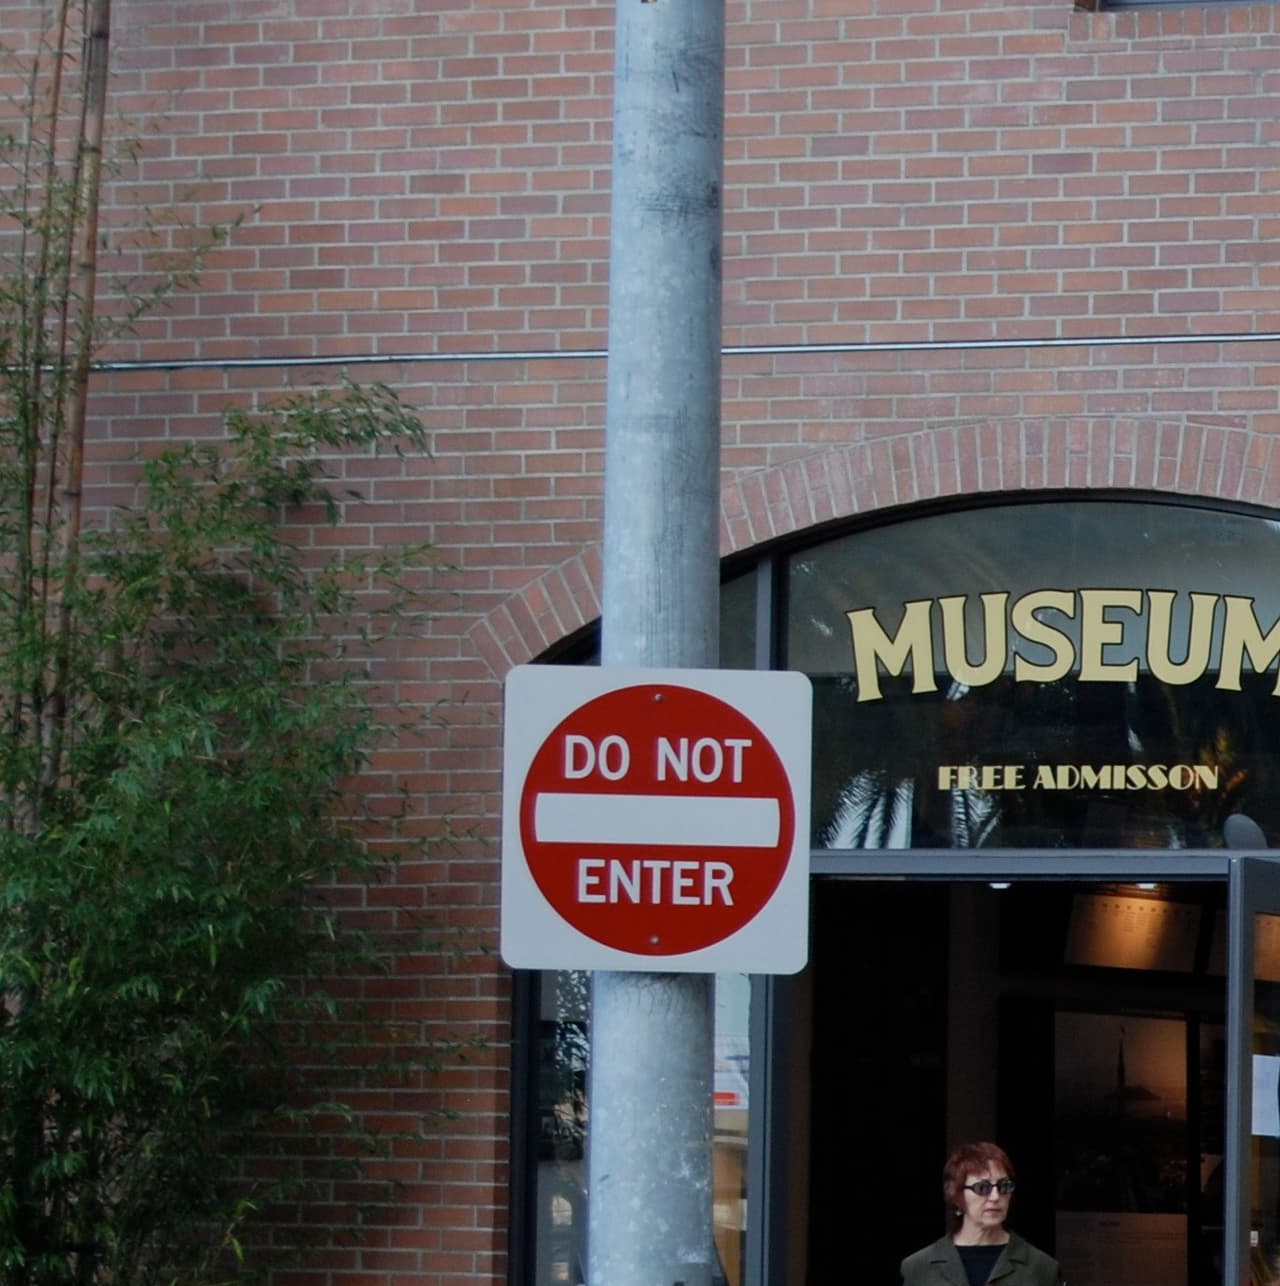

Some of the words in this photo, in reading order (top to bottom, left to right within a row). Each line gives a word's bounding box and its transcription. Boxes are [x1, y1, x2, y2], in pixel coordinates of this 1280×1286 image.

[564, 735, 630, 781] DO
[657, 737, 752, 783] NOT
[938, 765, 1025, 791] FREE
[1033, 764, 1218, 791] ADMISSON
[577, 858, 734, 907] ENTER
